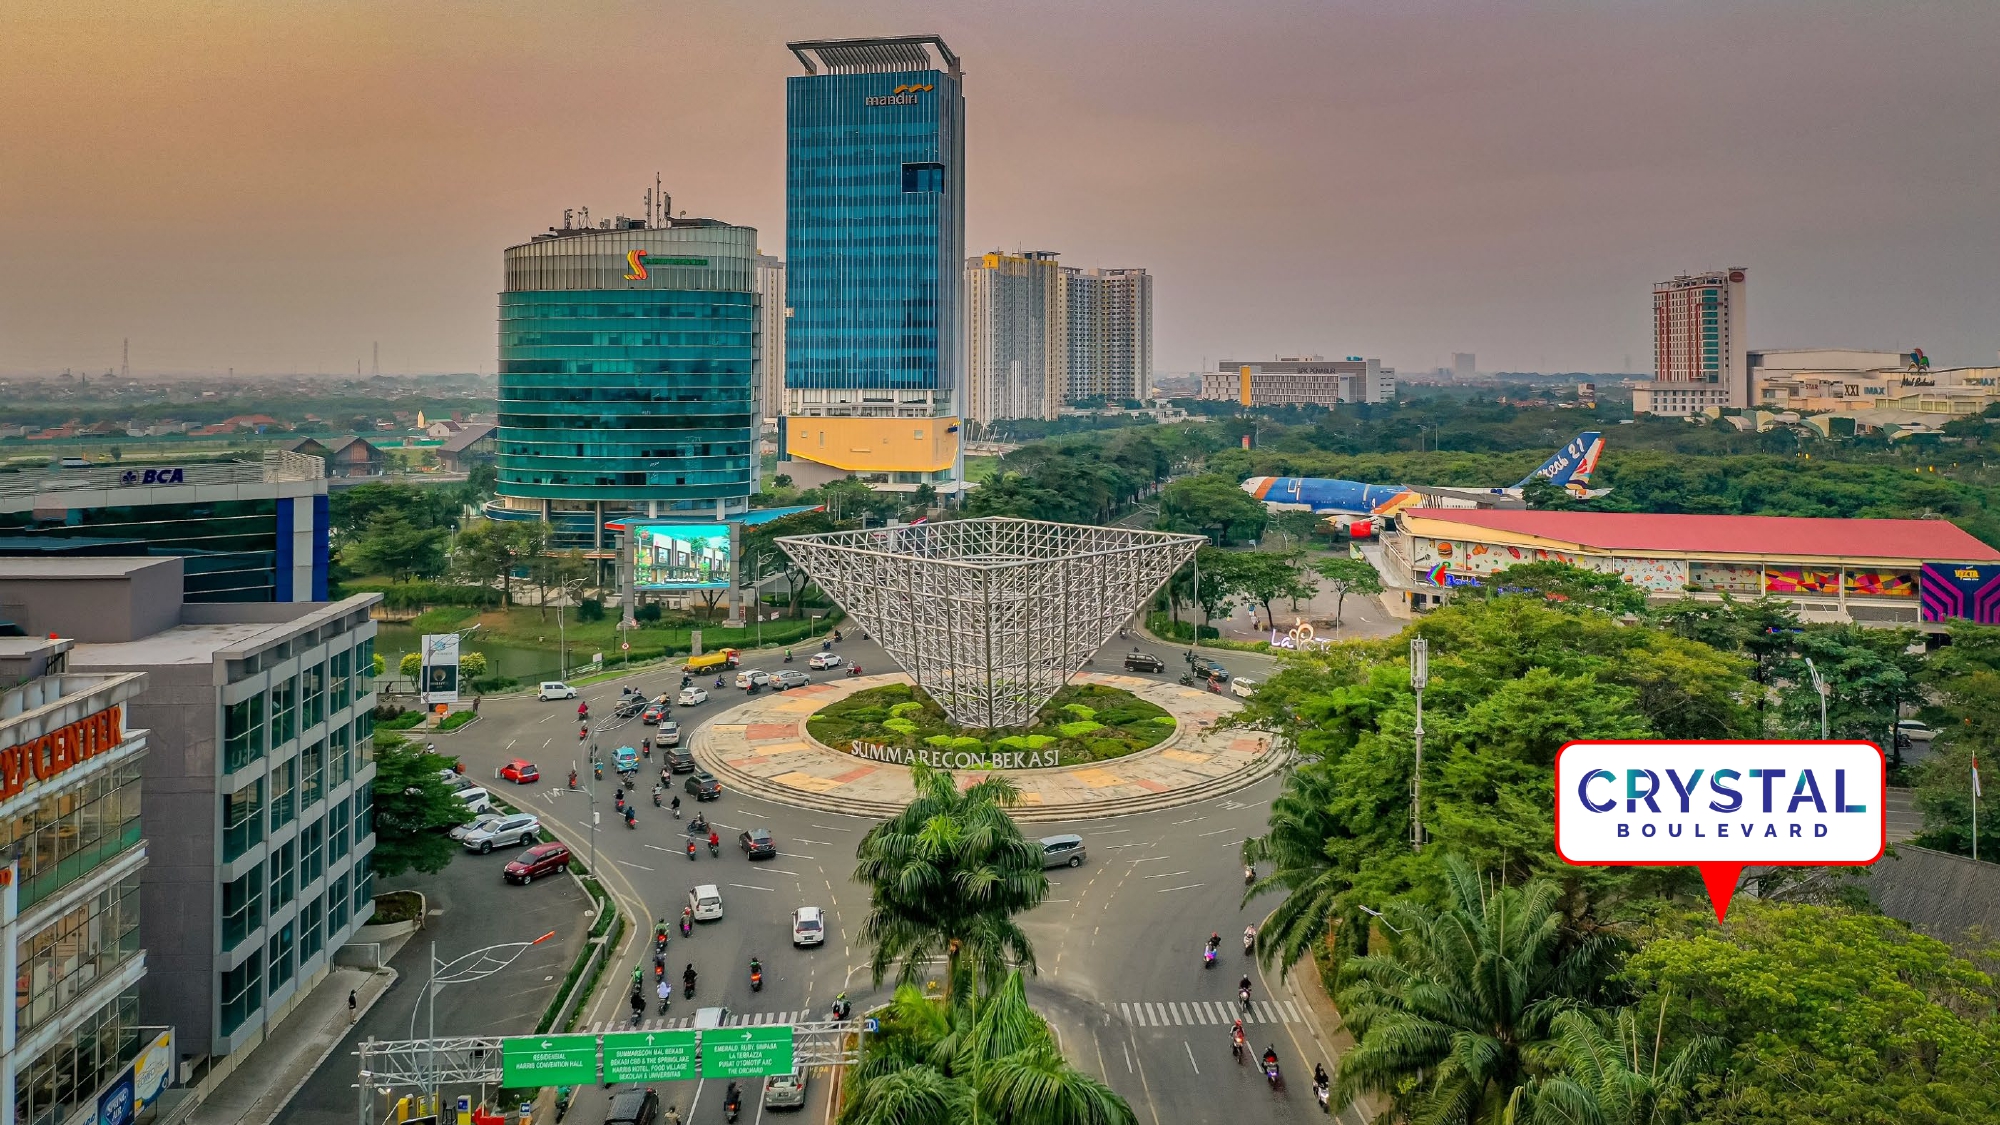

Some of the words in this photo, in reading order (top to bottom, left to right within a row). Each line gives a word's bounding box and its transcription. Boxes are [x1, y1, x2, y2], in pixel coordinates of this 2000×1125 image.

[865, 91, 918, 106] mandiri
[1844, 384, 1860, 397] XXI
[1863, 386, 1886, 396] IMAX
[1568, 437, 1585, 459] 21
[142, 468, 184, 485] BCA
[851, 739, 985, 769] SUMMARECON
[992, 750, 1059, 769] BEKASI
[536, 1061, 569, 1069] CONVENTION
